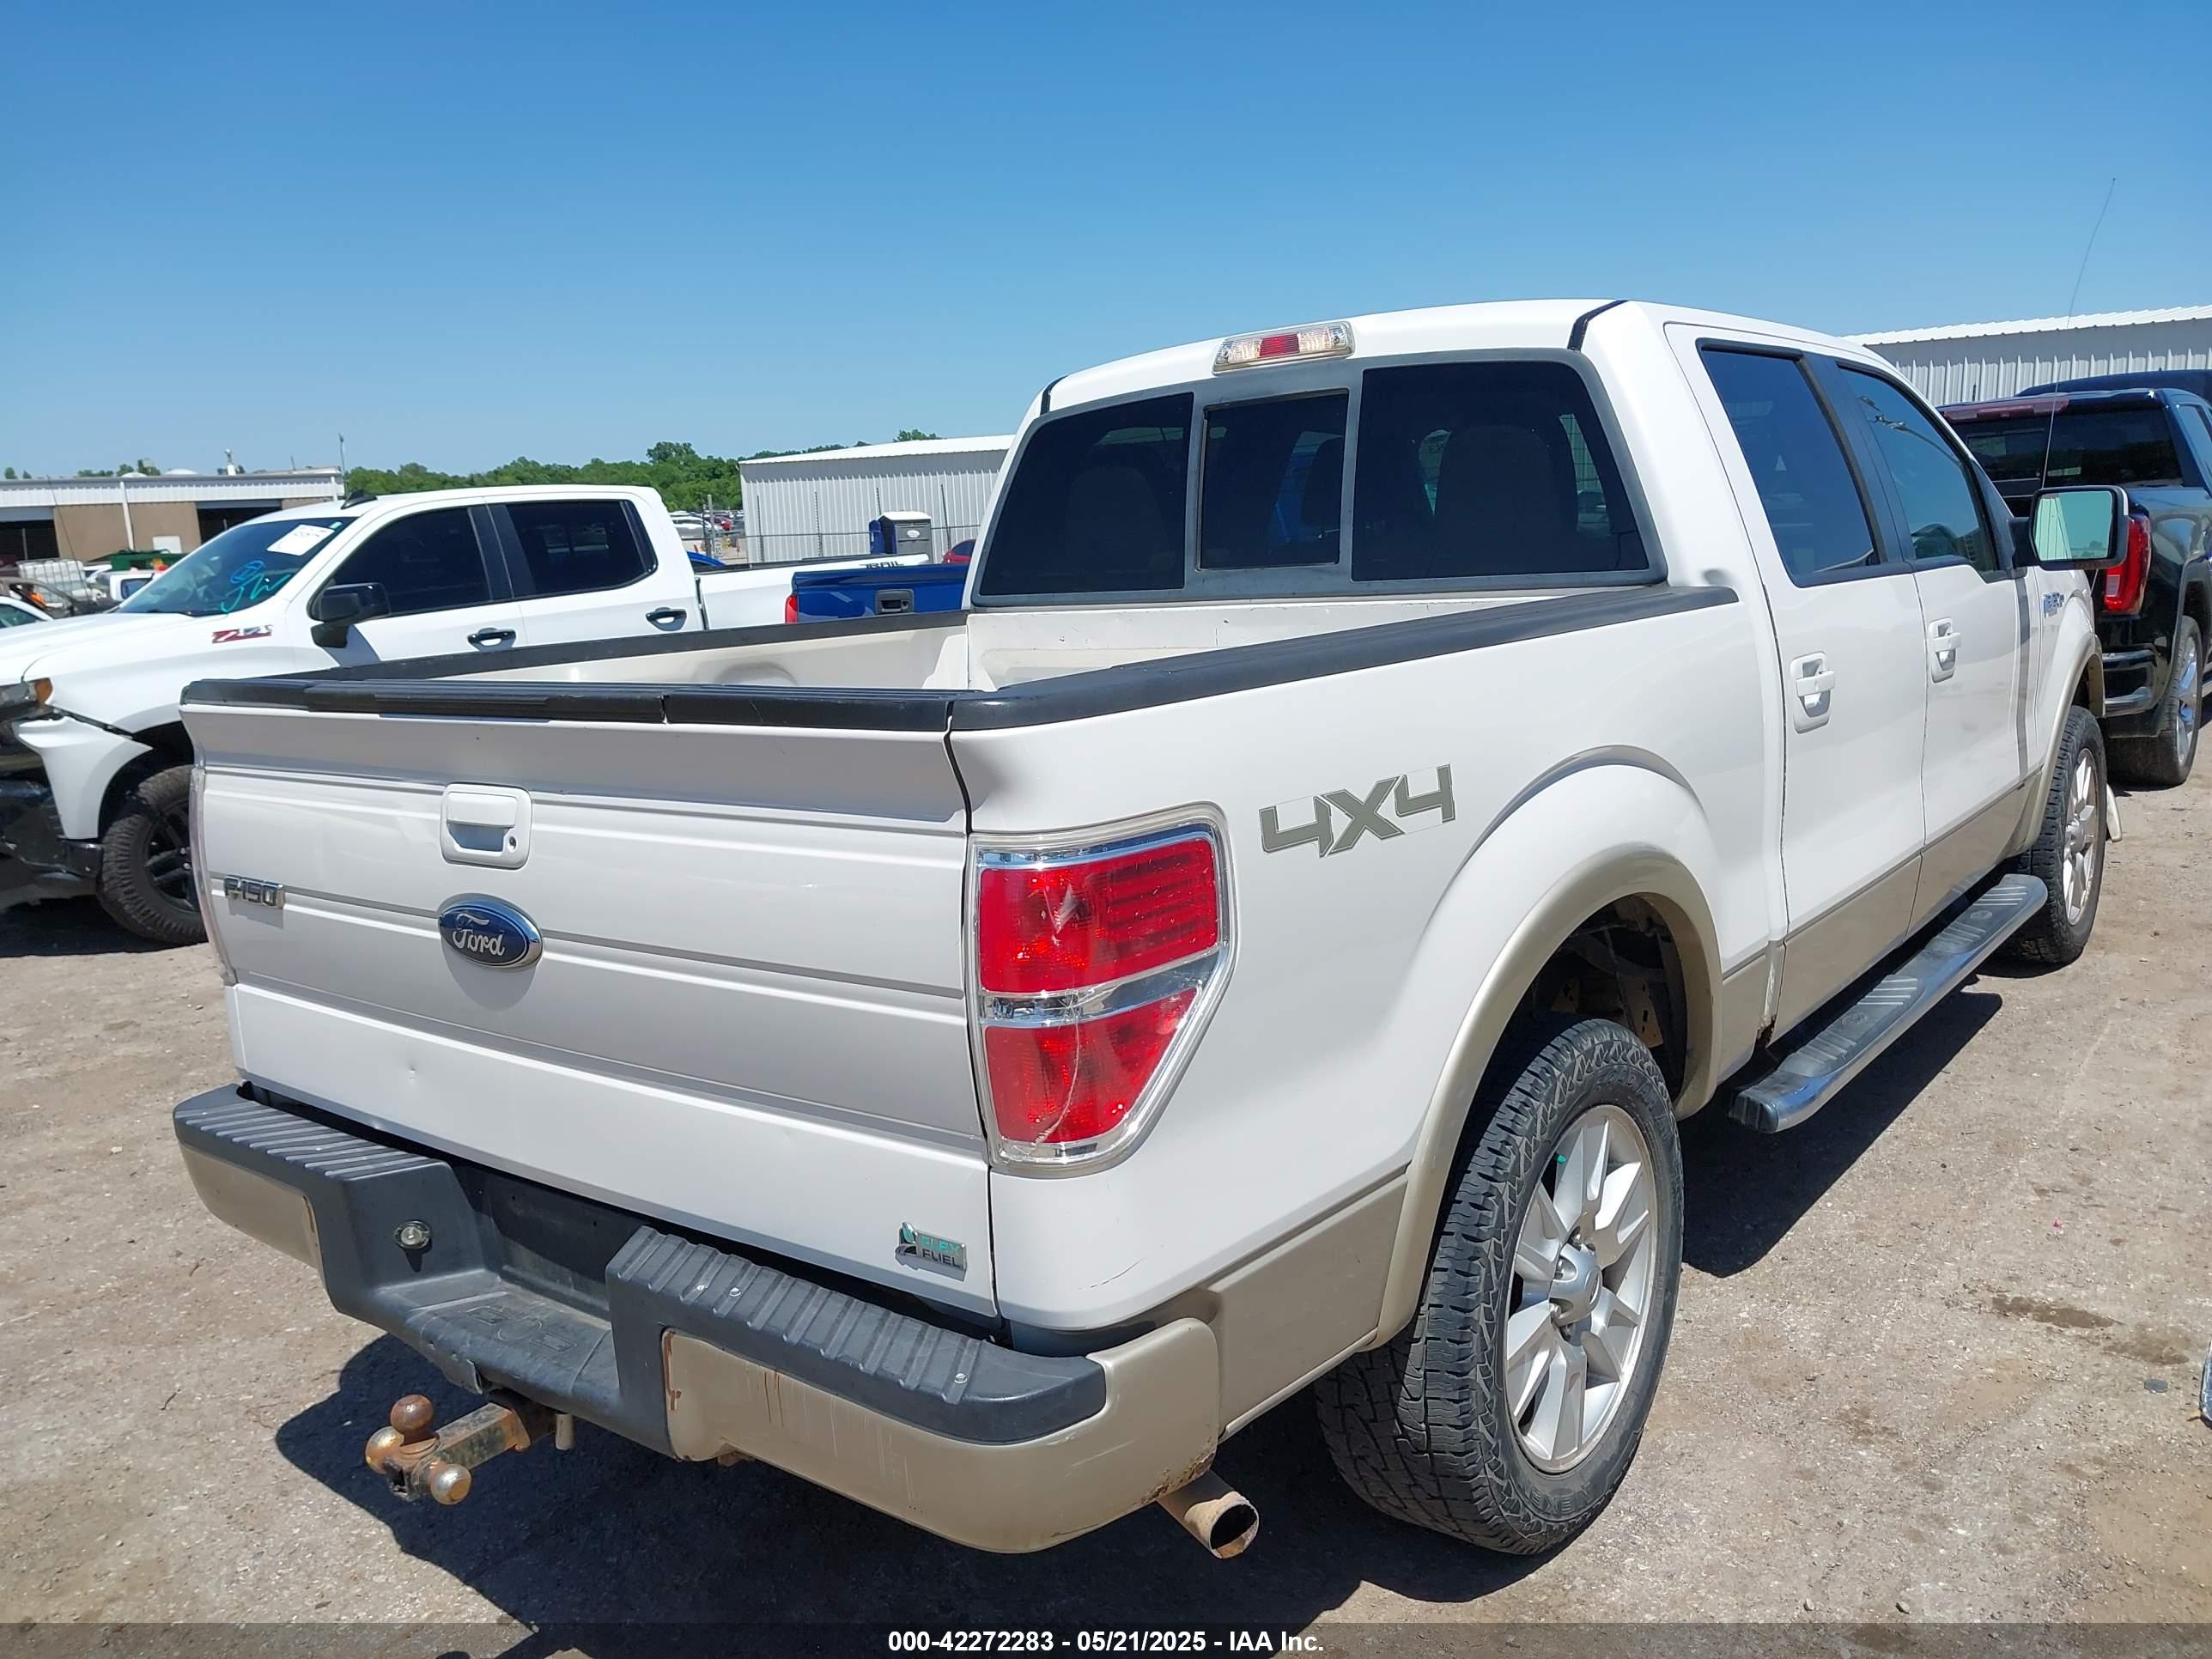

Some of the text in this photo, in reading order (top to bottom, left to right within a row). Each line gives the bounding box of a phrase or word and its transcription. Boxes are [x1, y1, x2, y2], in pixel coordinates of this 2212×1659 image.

[211, 624, 273, 644] Z71
[452, 912, 505, 956] Ford
[920, 1235, 963, 1254] FLEX
[922, 1249, 962, 1268] FUEL
